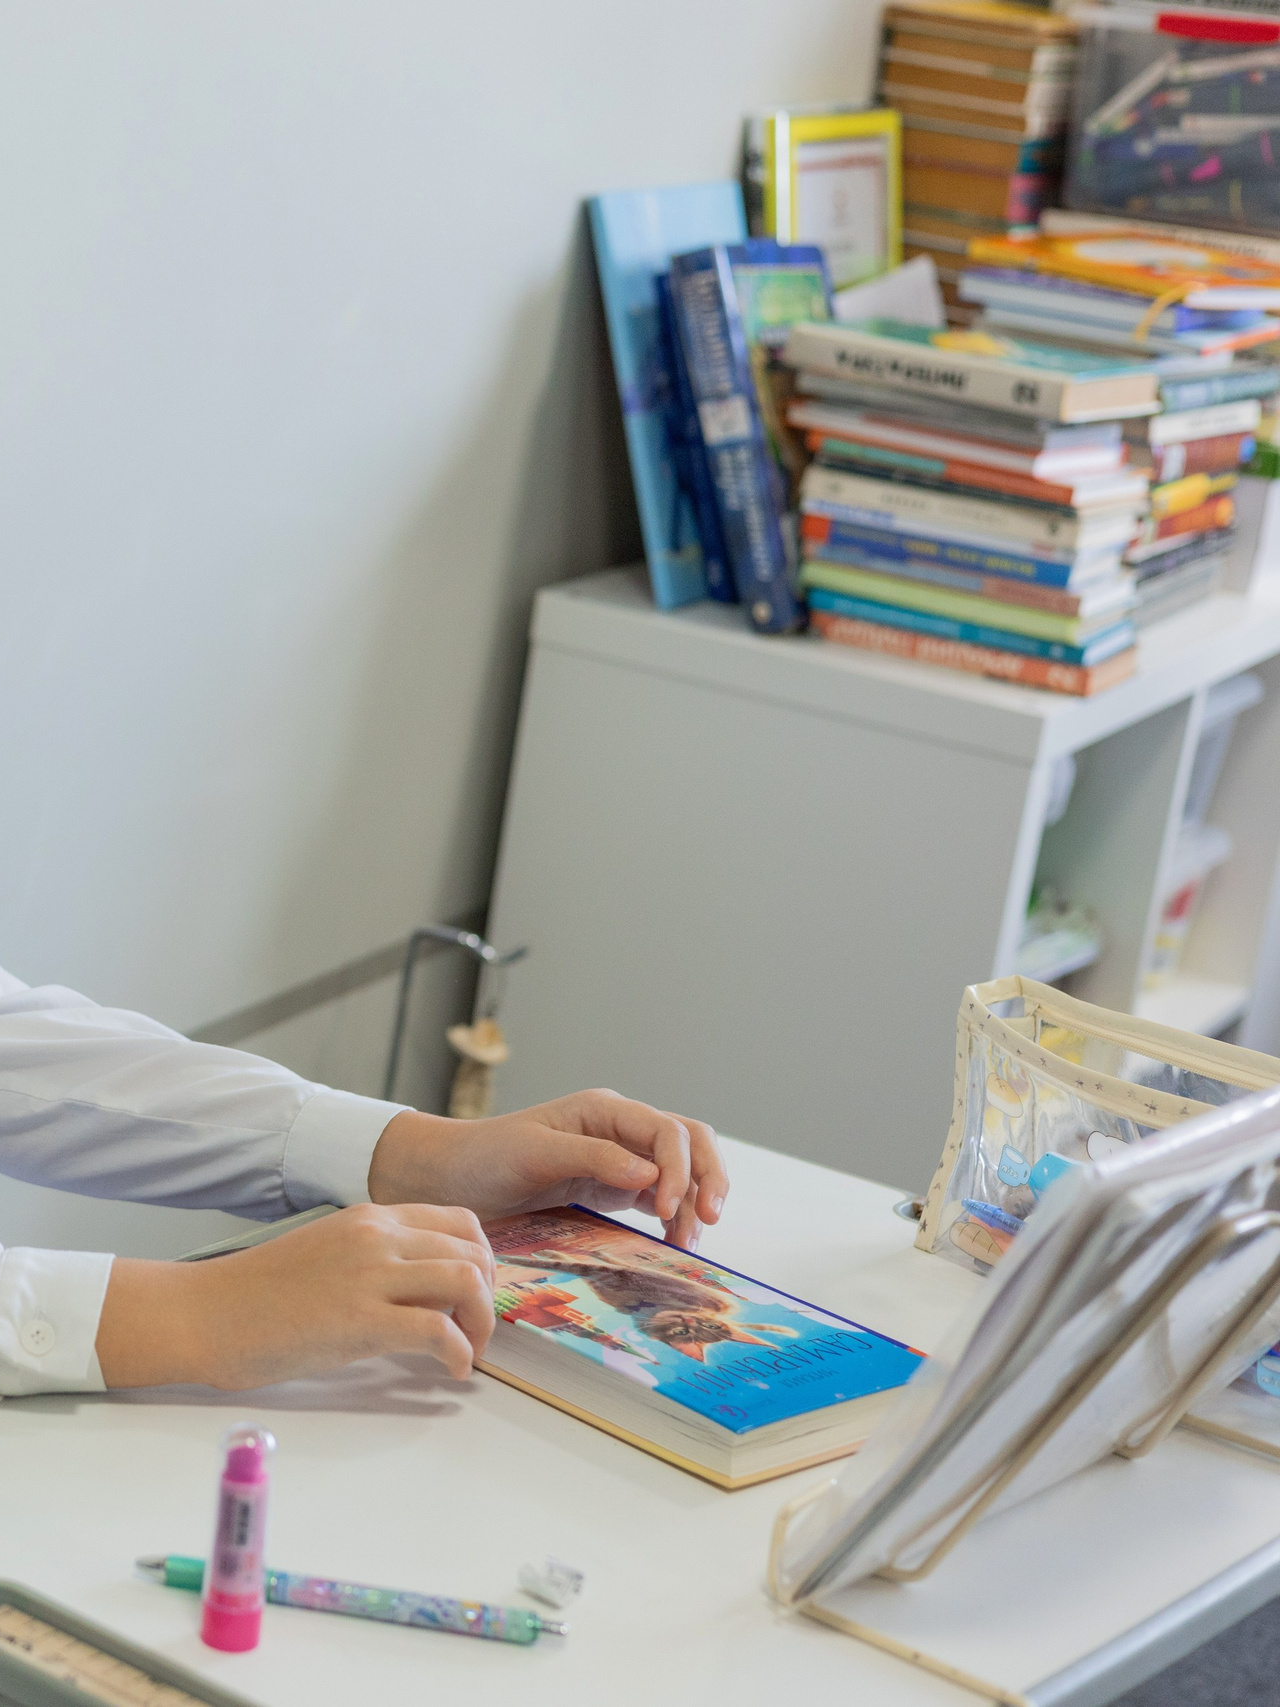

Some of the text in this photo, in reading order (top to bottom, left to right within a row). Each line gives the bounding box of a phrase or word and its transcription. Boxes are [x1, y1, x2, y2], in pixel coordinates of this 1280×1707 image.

[491, 1222, 596, 1253] ПРИКЛЮЧЕН
[677, 1332, 873, 1398] САМАРСКИЙ
[779, 1366, 840, 1389] МИХАИЛ
